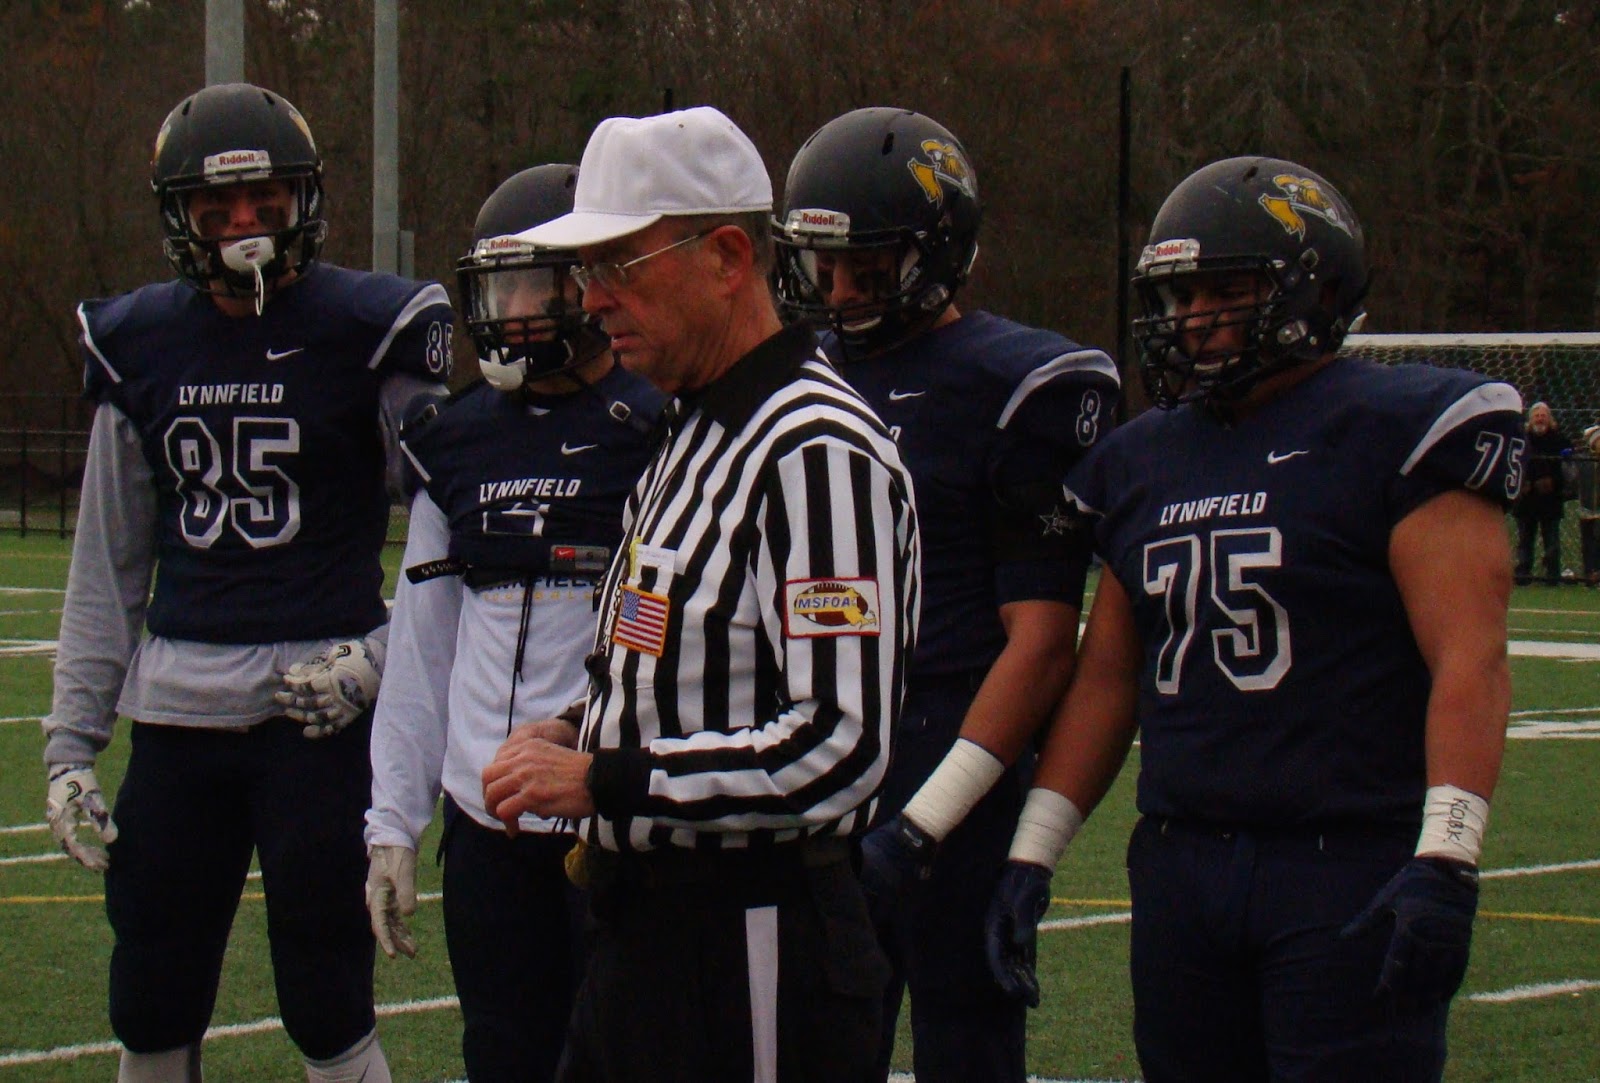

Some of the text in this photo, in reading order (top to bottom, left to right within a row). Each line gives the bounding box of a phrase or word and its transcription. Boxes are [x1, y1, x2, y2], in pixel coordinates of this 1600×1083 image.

[219, 153, 255, 166] Riddell
[802, 213, 835, 225] Riddell
[426, 321, 454, 376] 85
[178, 384, 285, 406] LYNNFIELD
[1464, 430, 1526, 500] 75
[164, 416, 301, 549] 85
[479, 478, 581, 504] LYNNFIELD
[1159, 491, 1268, 527] LYNNFIELD
[798, 596, 851, 609] MSFOA
[1143, 526, 1293, 695] 75
